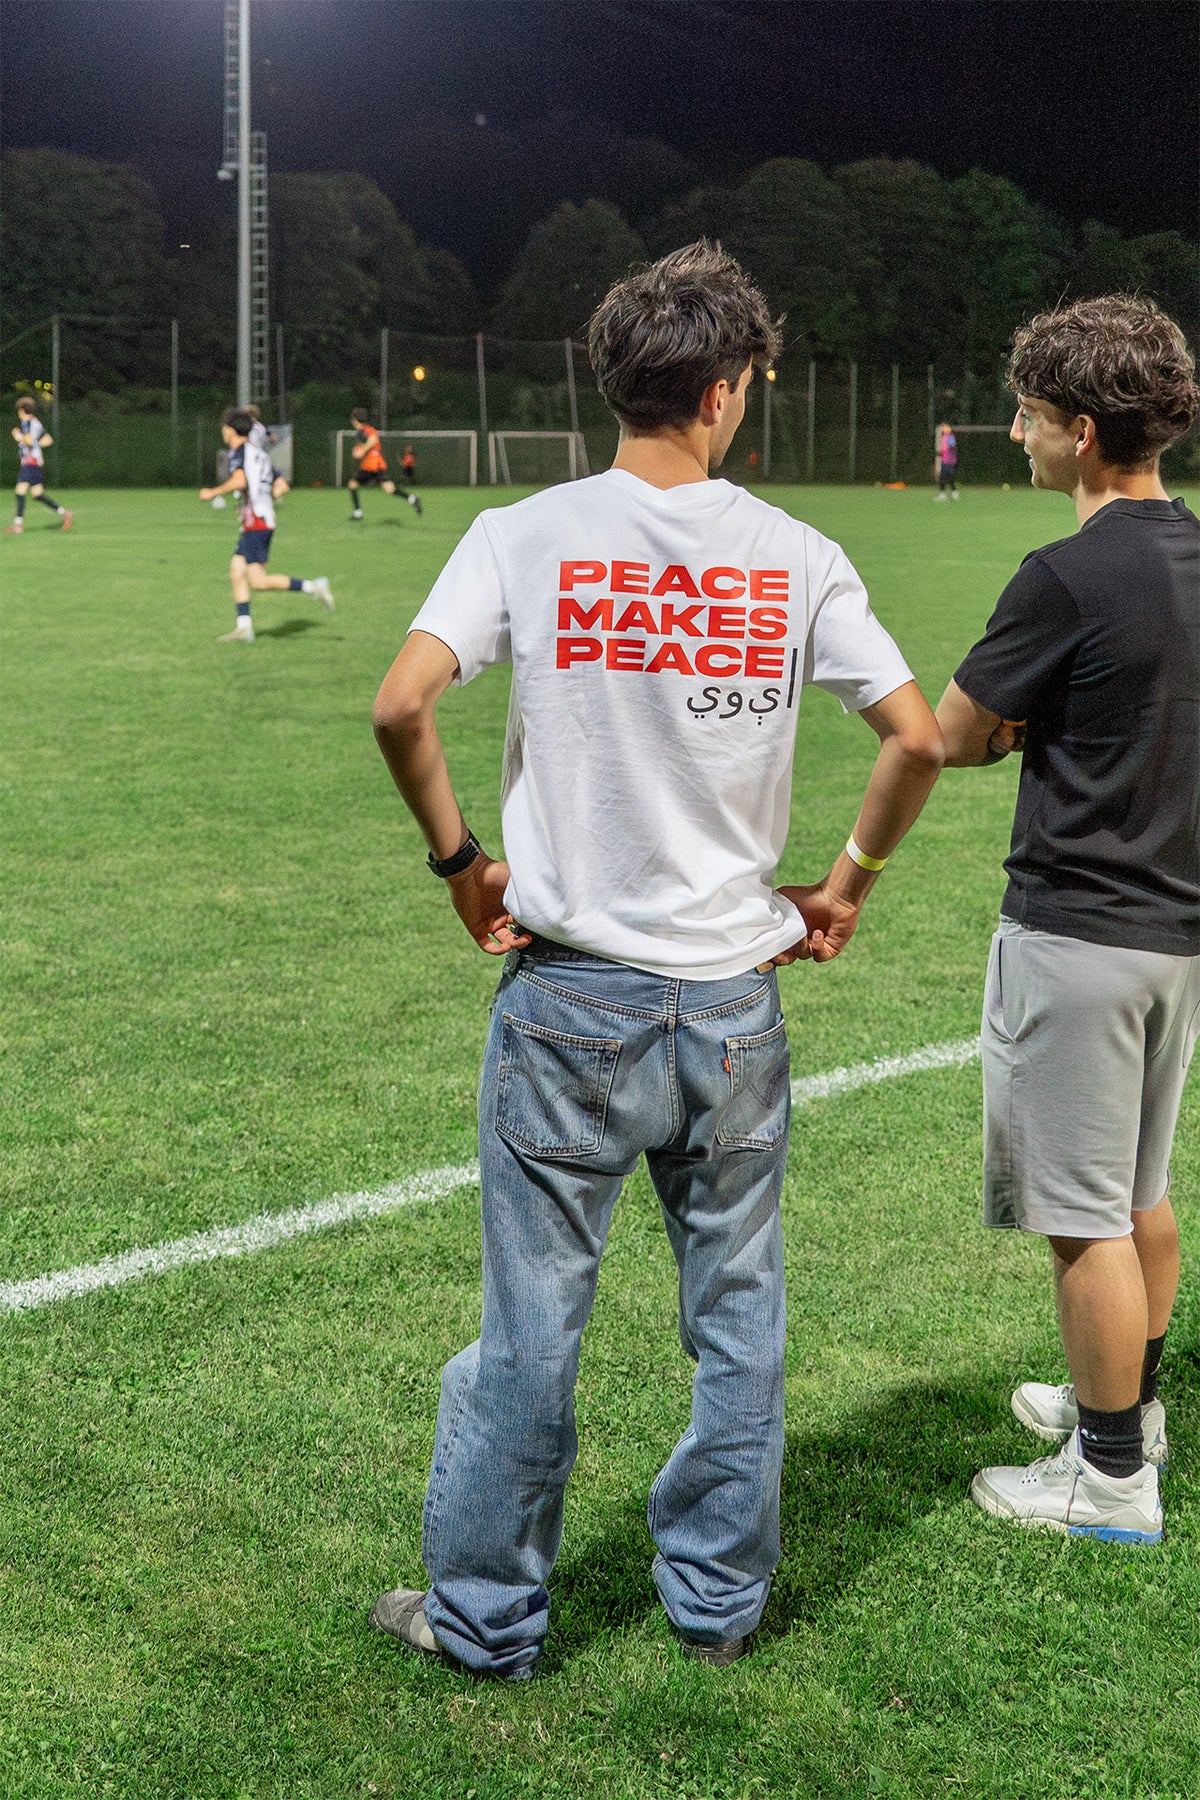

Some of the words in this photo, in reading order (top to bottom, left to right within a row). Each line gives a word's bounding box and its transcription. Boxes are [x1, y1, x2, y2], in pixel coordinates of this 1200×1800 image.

[559, 560, 789, 602] PEACE
[557, 598, 789, 640] MAKES
[556, 637, 785, 678] PEACE
